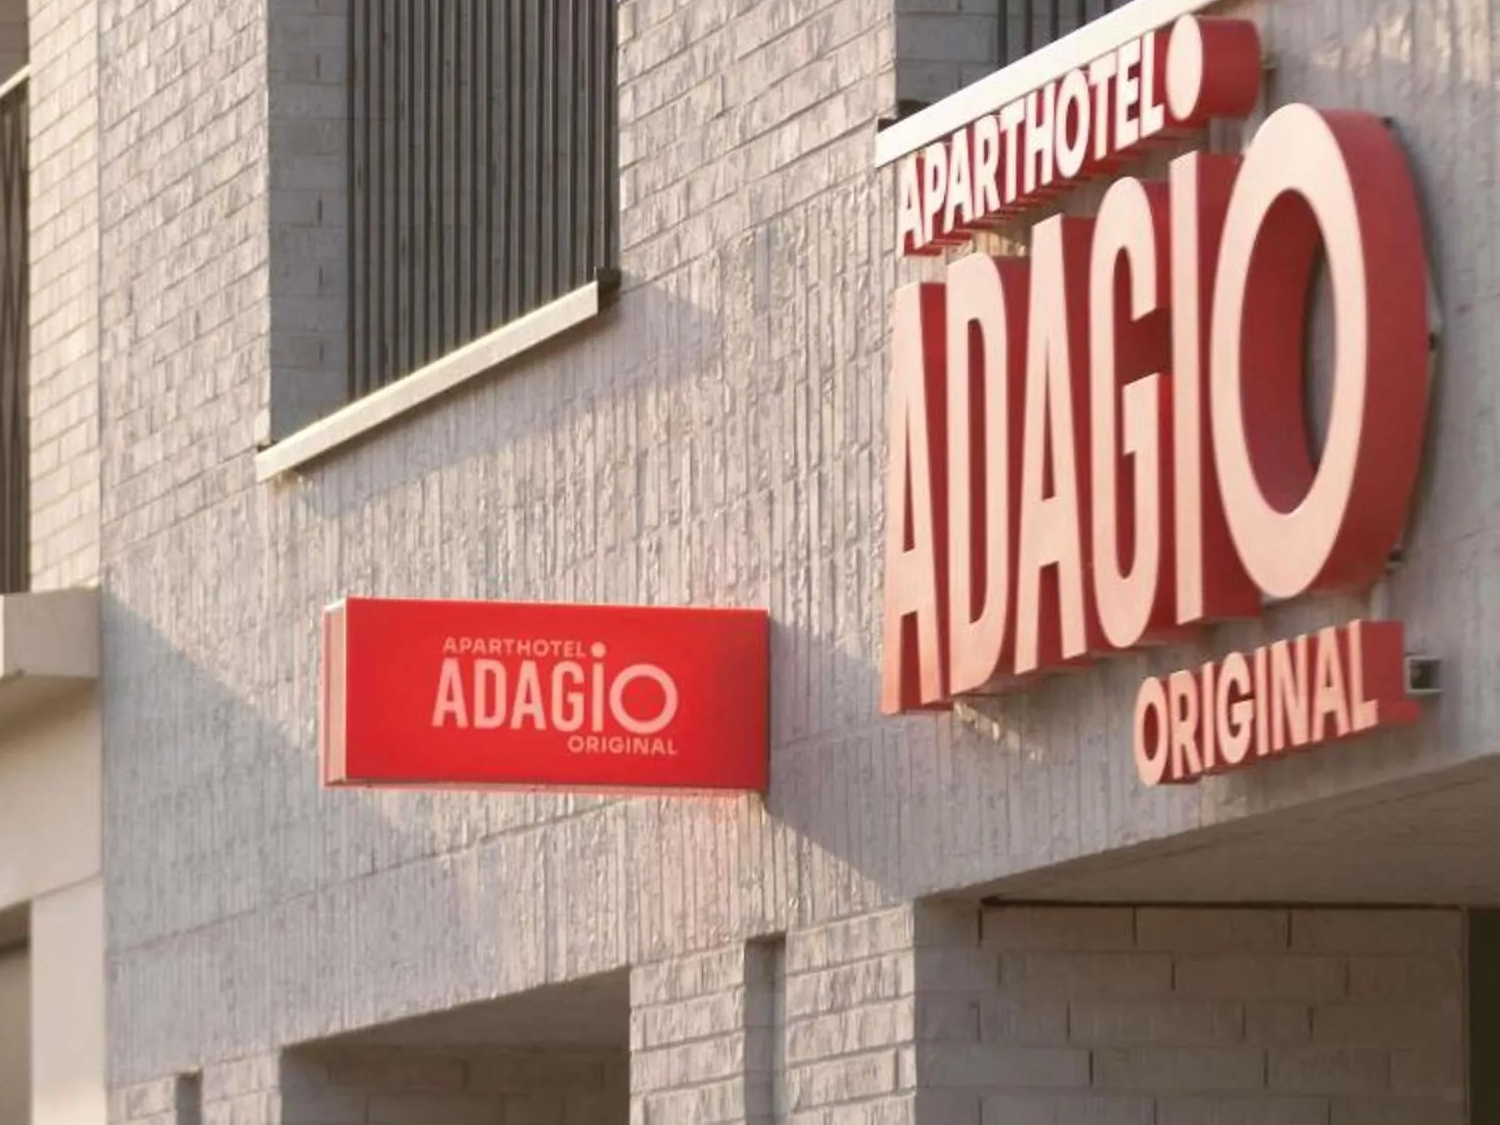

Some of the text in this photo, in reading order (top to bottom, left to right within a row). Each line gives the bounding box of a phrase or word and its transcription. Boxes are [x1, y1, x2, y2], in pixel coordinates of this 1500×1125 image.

[899, 29, 1165, 256] APARTHOTEL
[442, 636, 586, 658] APARTHOTEL
[567, 735, 678, 756] ORIGINAL
[1133, 620, 1379, 788] ORIGINAL
